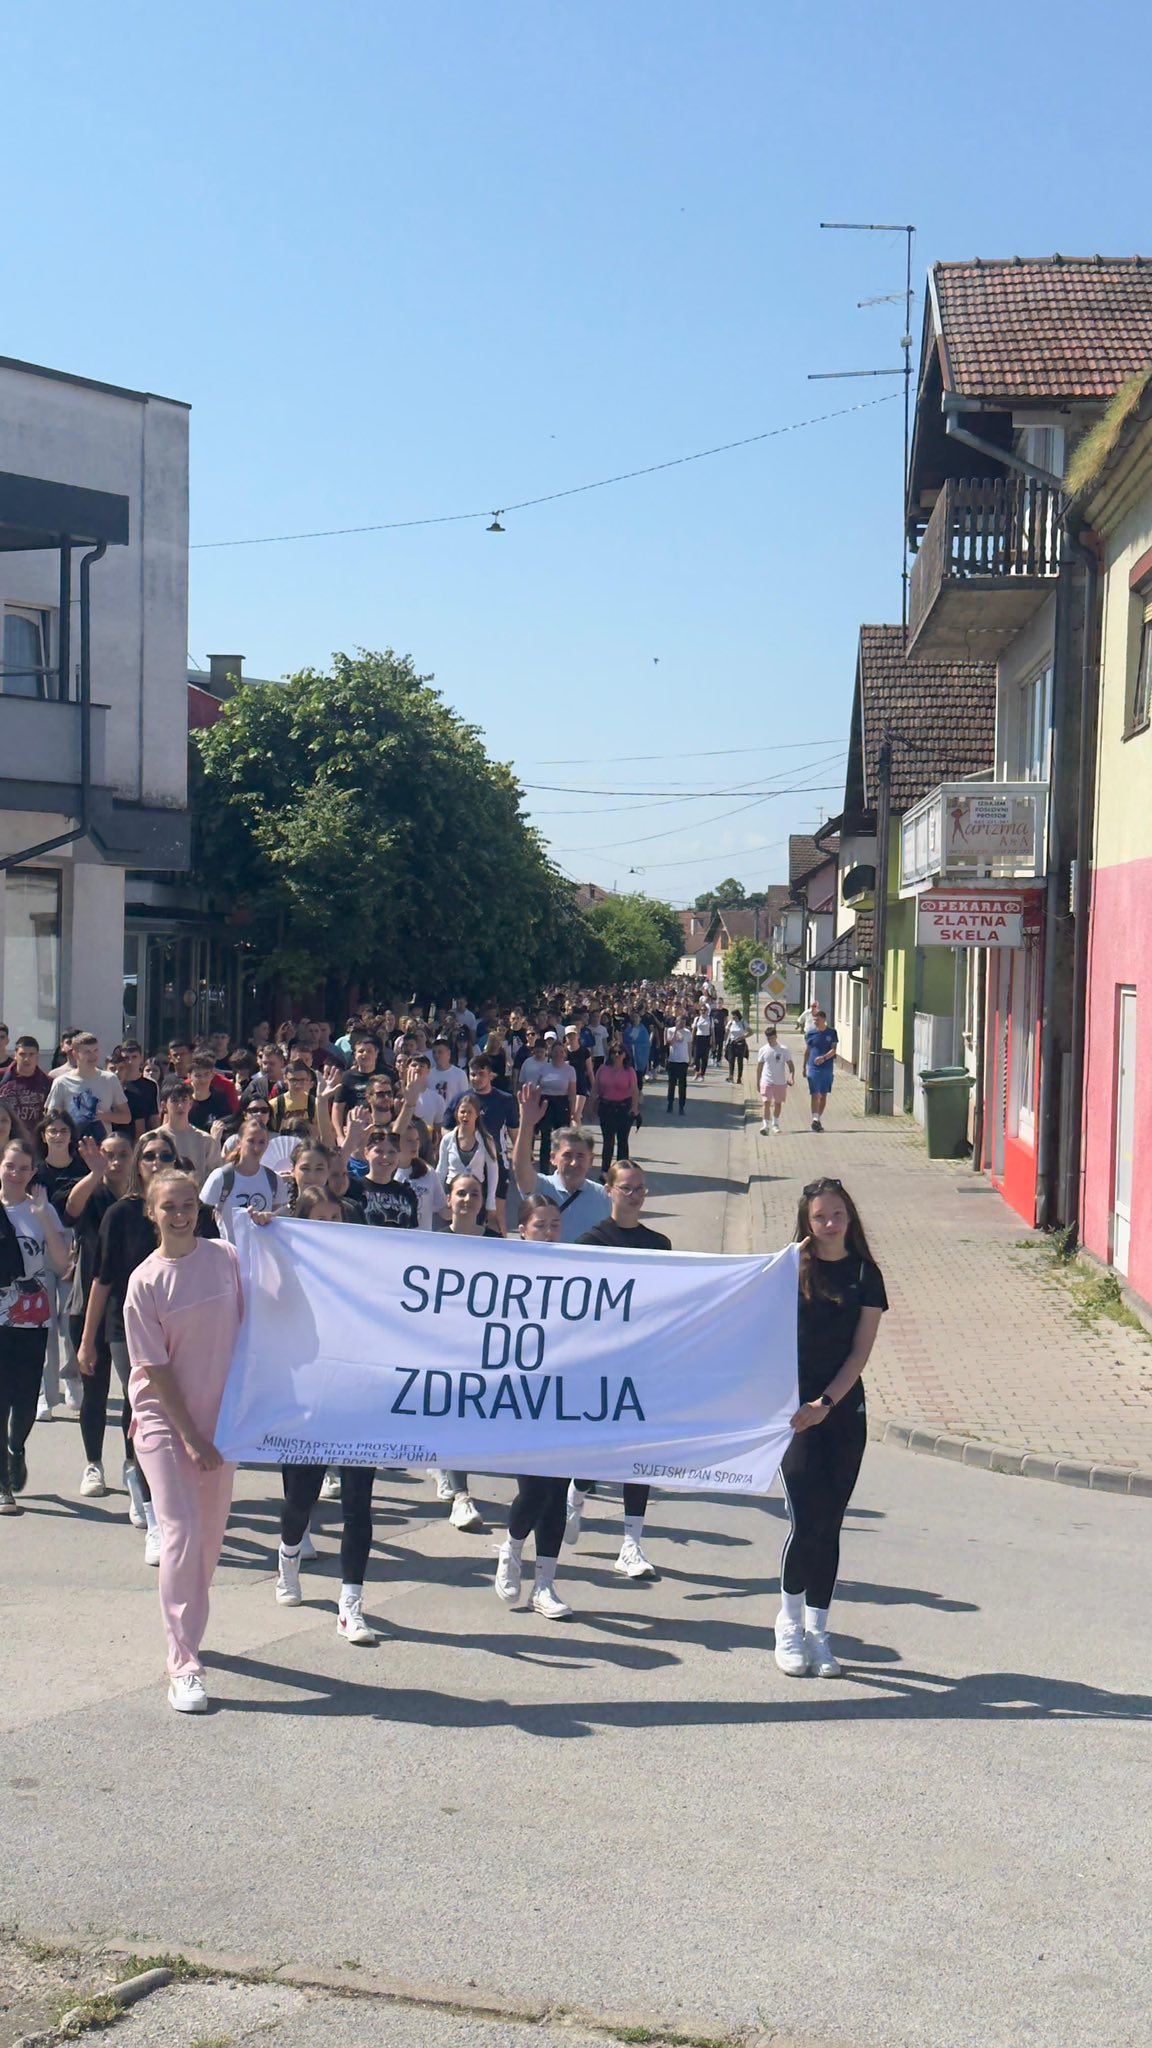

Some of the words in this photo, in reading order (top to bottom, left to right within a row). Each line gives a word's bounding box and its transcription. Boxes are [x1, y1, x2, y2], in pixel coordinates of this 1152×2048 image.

[938, 901, 1002, 912] PEKARA
[933, 915, 1007, 927] ZLATNA
[940, 929, 999, 941] SKELA
[400, 1265, 635, 1322] SPORTOM
[481, 1322, 545, 1371] DO
[391, 1367, 645, 1421] ZDRAVLJA
[633, 1462, 687, 1479] SVJETSKI
[688, 1468, 711, 1481] DAN
[714, 1470, 753, 1484] SPORTA
